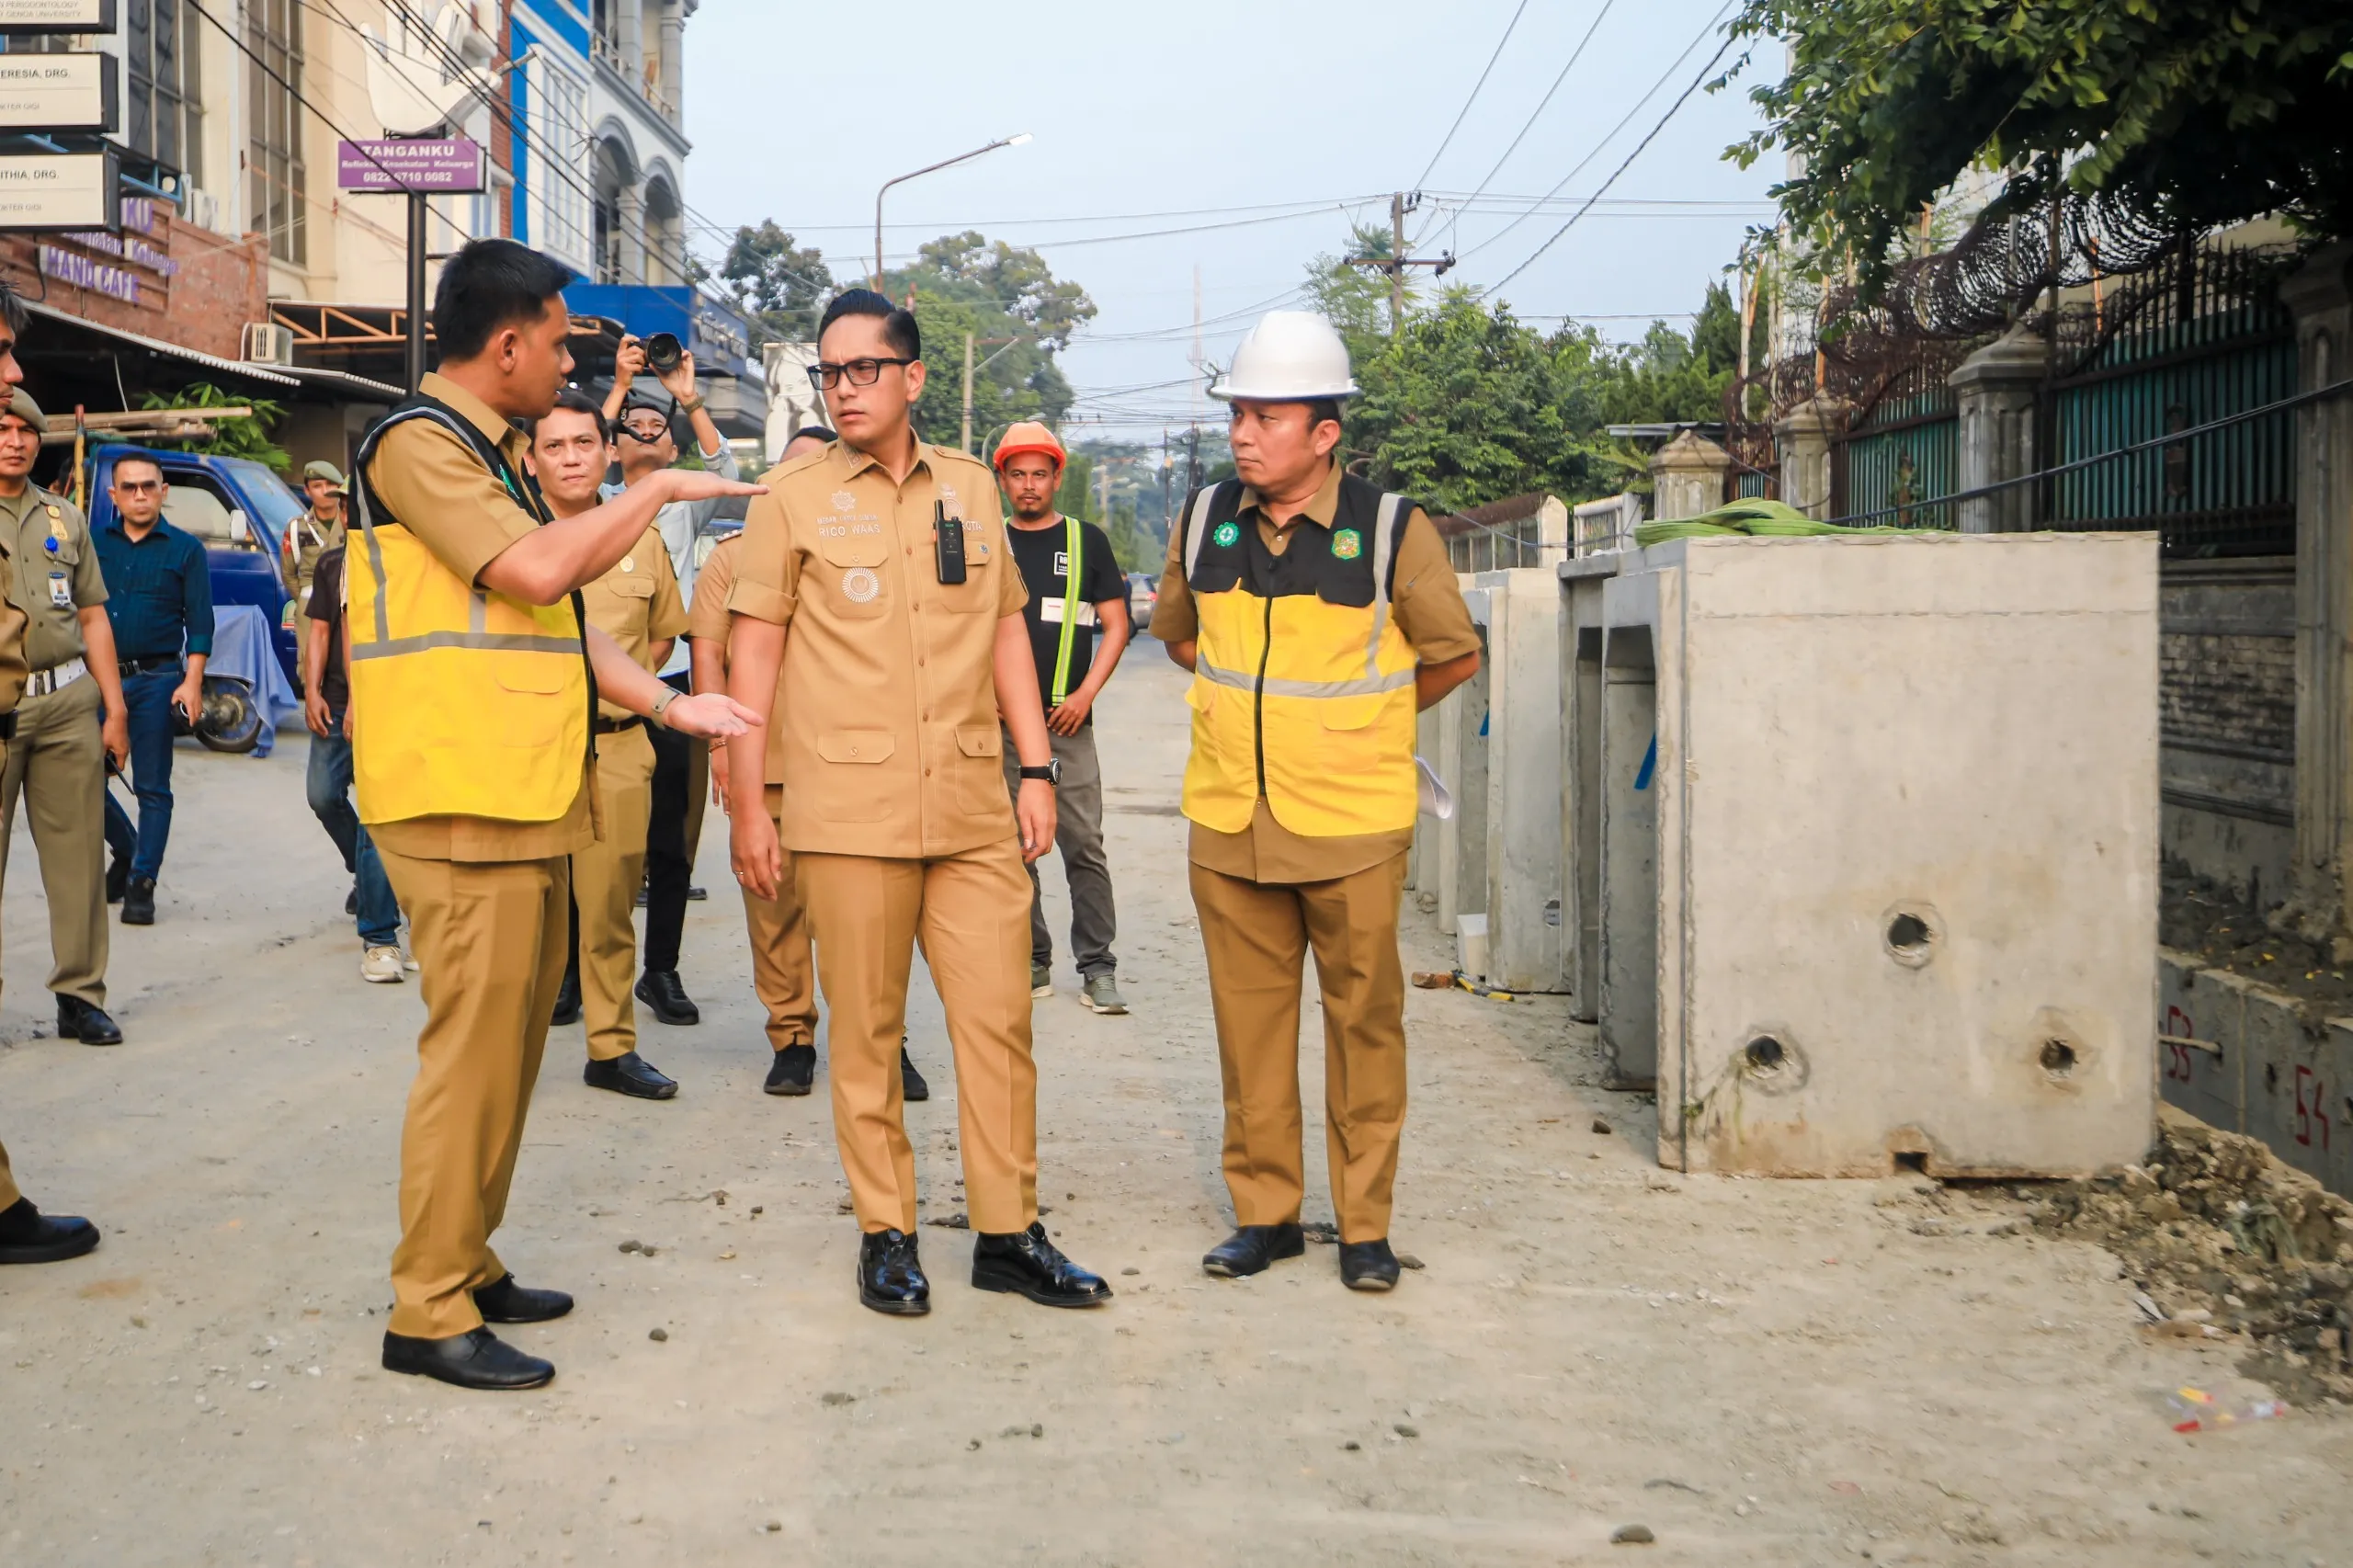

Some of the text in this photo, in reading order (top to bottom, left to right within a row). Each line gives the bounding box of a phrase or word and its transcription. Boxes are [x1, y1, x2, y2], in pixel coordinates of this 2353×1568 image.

[361, 145, 455, 157] TANGANKU
[433, 160, 474, 169] Keluarga
[363, 172, 452, 183] 0822 6710 0082
[818, 524, 881, 537] RICO WAAS
[2295, 1063, 2330, 1153] 54
